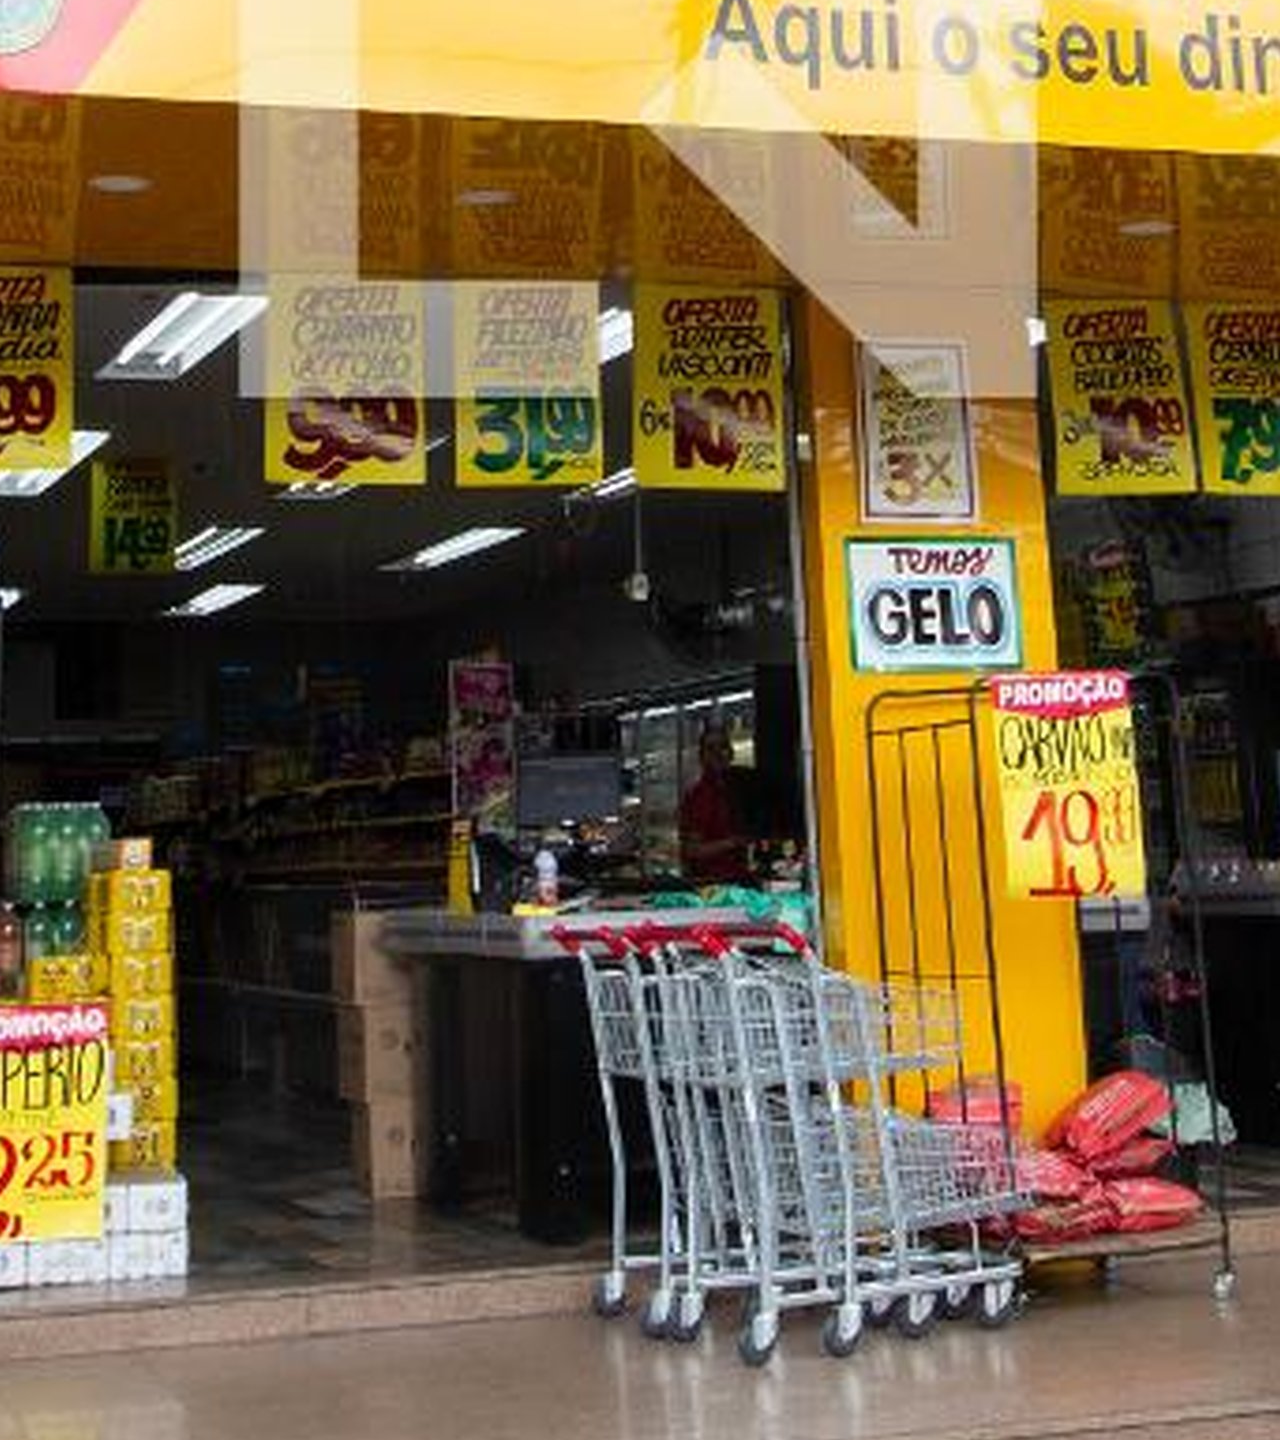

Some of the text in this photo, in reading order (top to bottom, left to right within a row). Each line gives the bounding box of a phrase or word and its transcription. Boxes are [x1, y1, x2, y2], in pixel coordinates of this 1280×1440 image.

[929, 13, 982, 76] o
[1010, 12, 1150, 87] seu
[662, 296, 759, 326] OFERTA
[1063, 305, 1148, 338] OFERTA
[867, 583, 1006, 646] GELO
[999, 678, 1125, 706] PROMOÇÃO
